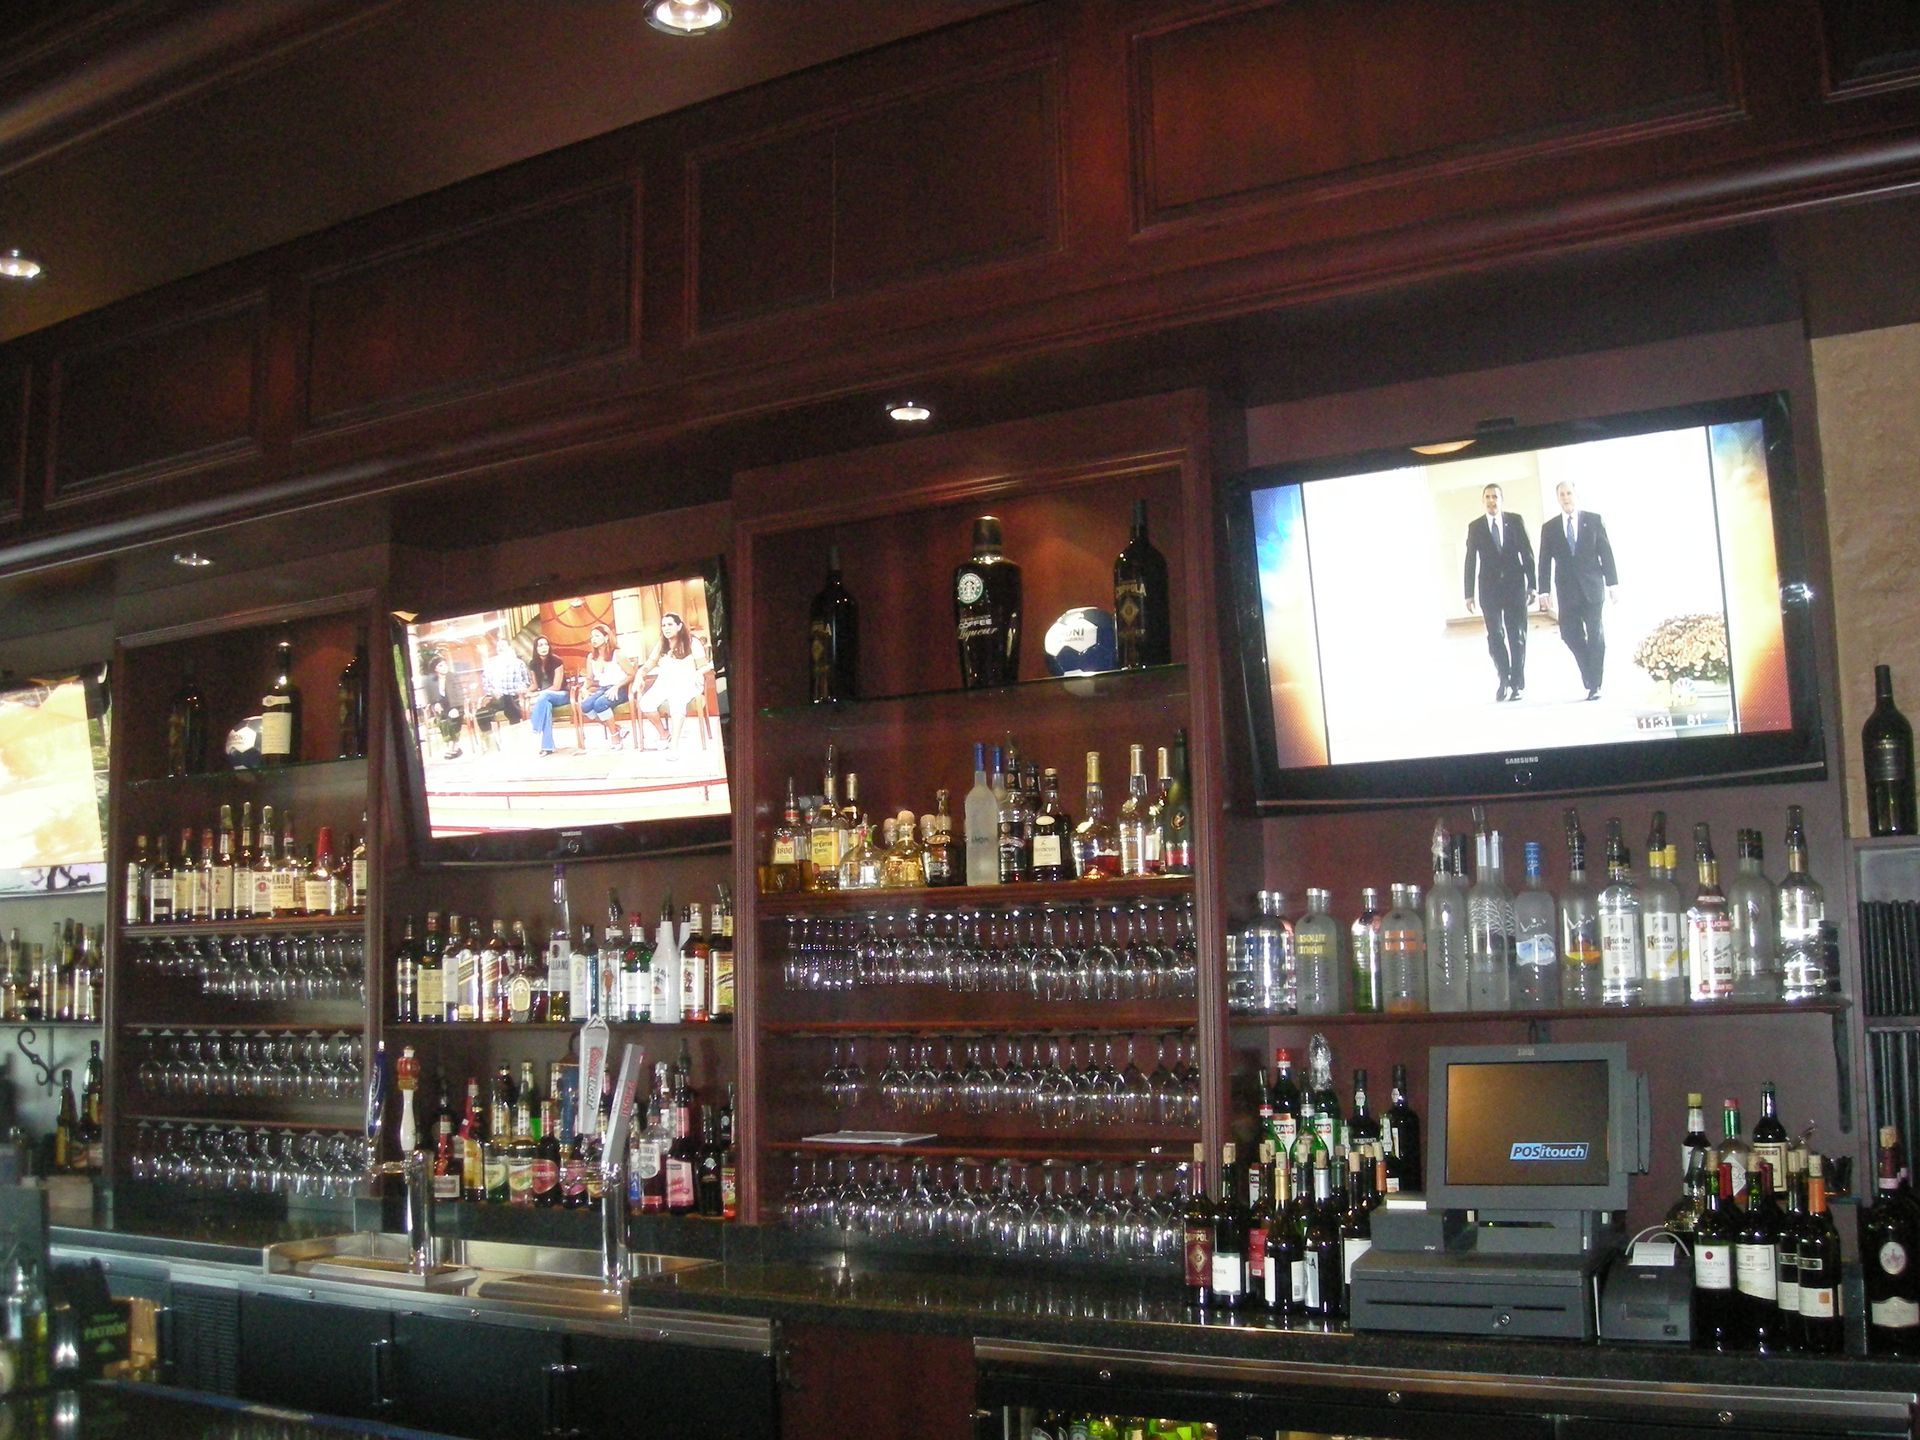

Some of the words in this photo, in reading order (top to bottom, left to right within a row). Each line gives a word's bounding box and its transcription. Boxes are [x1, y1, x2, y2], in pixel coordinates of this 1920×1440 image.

[958, 618, 993, 630] COFFEE
[1504, 756, 1539, 765] SAMSUNG
[776, 847, 793, 855] 1800
[1512, 1144, 1585, 1158] POSitouch
